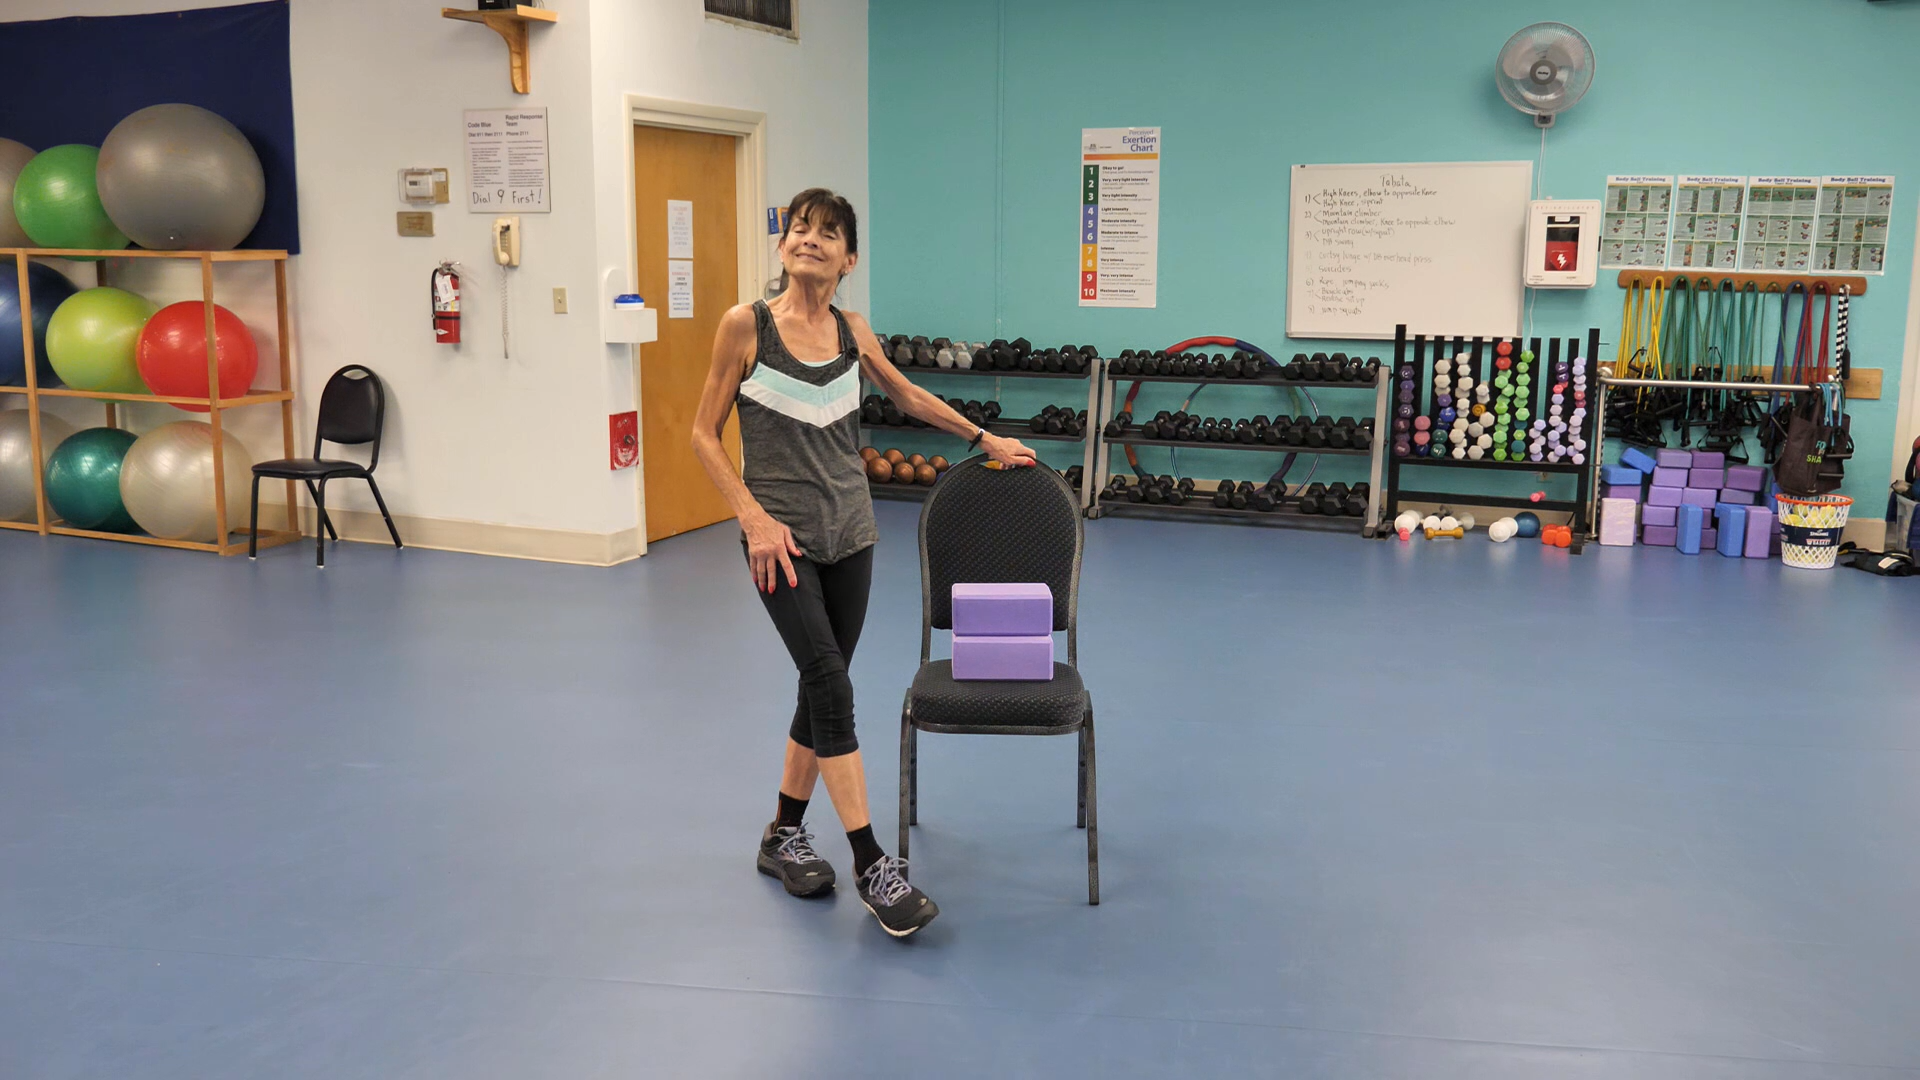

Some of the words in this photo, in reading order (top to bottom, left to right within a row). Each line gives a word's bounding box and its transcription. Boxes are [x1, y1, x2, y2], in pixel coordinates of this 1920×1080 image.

[1130, 144, 1153, 152] Chart
[1088, 180, 1094, 188] 2
[1380, 173, 1411, 187] Tabata
[472, 192, 491, 204] Dial
[497, 189, 505, 204] 9
[1323, 188, 1337, 200] High
[1363, 188, 1382, 196] elbow
[1384, 188, 1390, 196] to
[1392, 186, 1420, 199] opposite
[1324, 199, 1337, 210] High
[1323, 208, 1352, 217] Mountain
[1355, 208, 1381, 217] climber
[1088, 220, 1093, 228] 5
[1434, 216, 1455, 225] elbow
[1342, 251, 1360, 263] lunge
[1384, 252, 1411, 263] overhead
[1414, 255, 1432, 266] press
[1306, 278, 1314, 286] 6)
[1084, 288, 1094, 296] 10
[1816, 440, 1827, 450] FO
